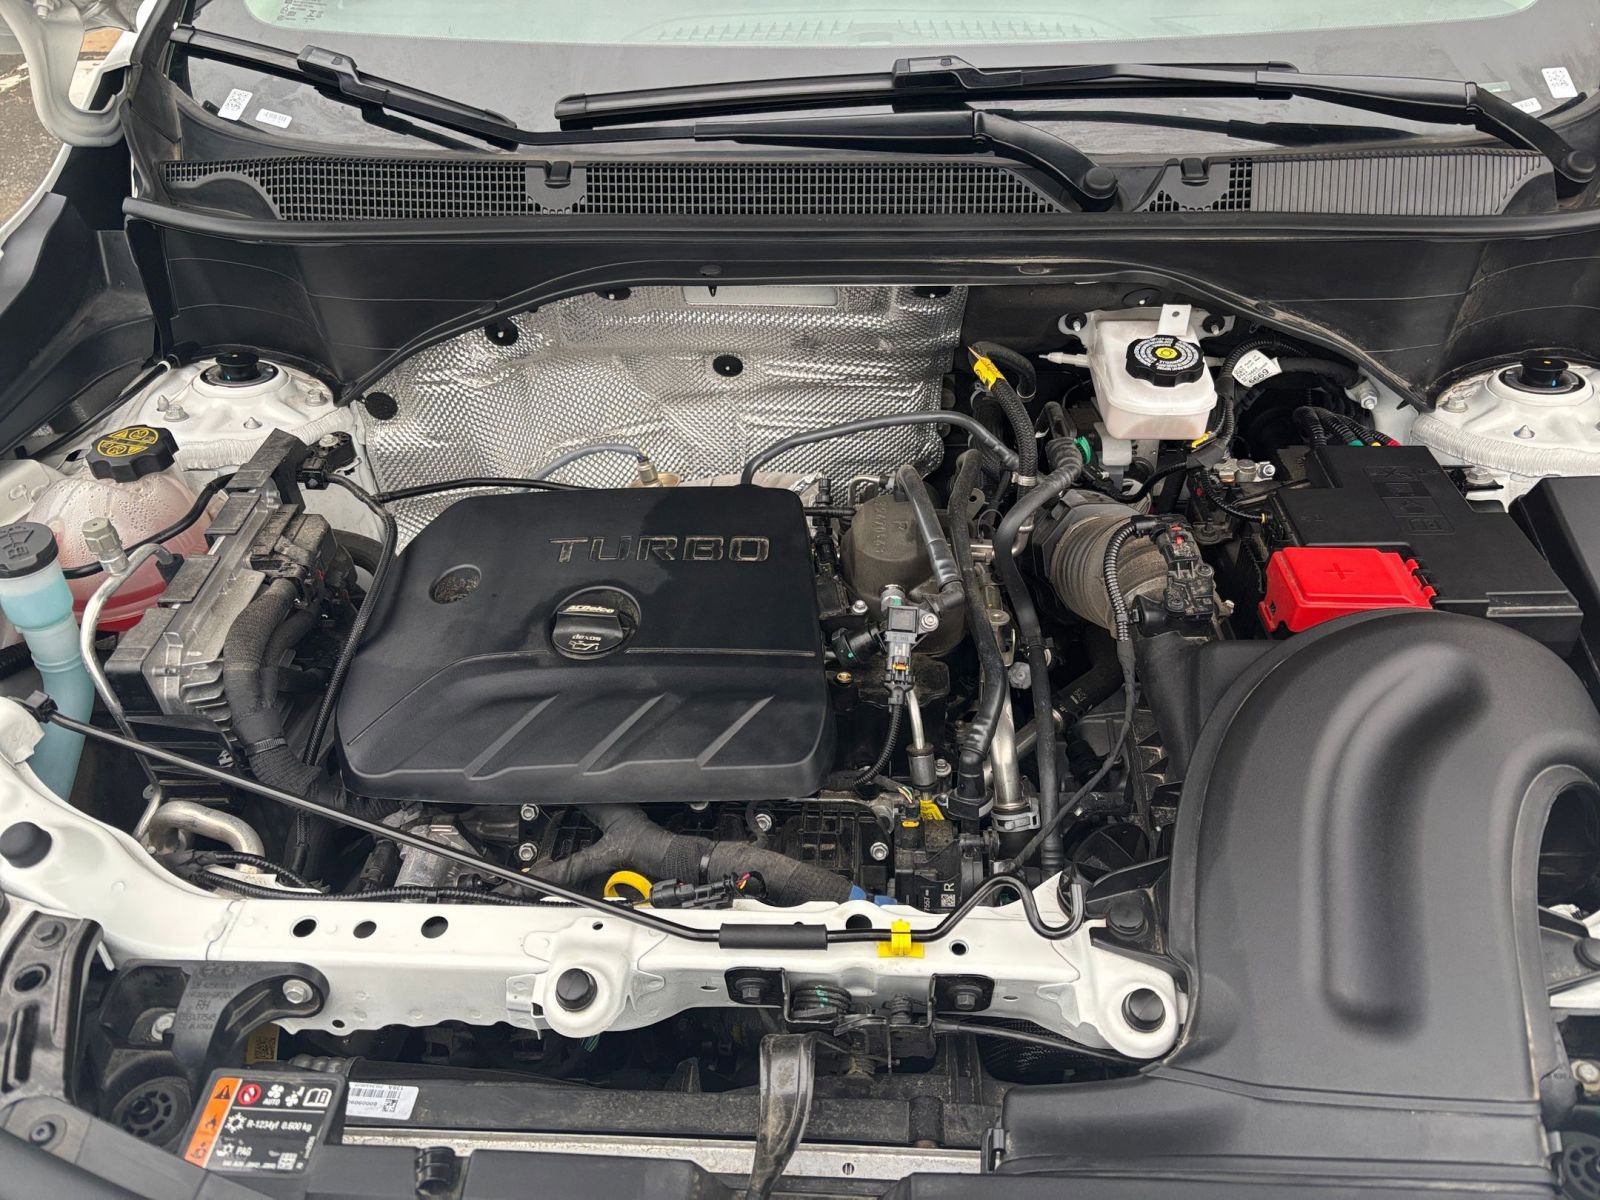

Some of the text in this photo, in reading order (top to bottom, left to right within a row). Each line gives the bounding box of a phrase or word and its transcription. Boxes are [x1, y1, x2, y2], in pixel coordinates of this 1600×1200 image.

[549, 535, 770, 562] TURBO
[943, 882, 955, 892] R
[262, 1098, 281, 1106] AUTO
[246, 1119, 280, 1132] R-1234yf
[301, 1123, 312, 1133] kg
[235, 1146, 253, 1157] PAG
